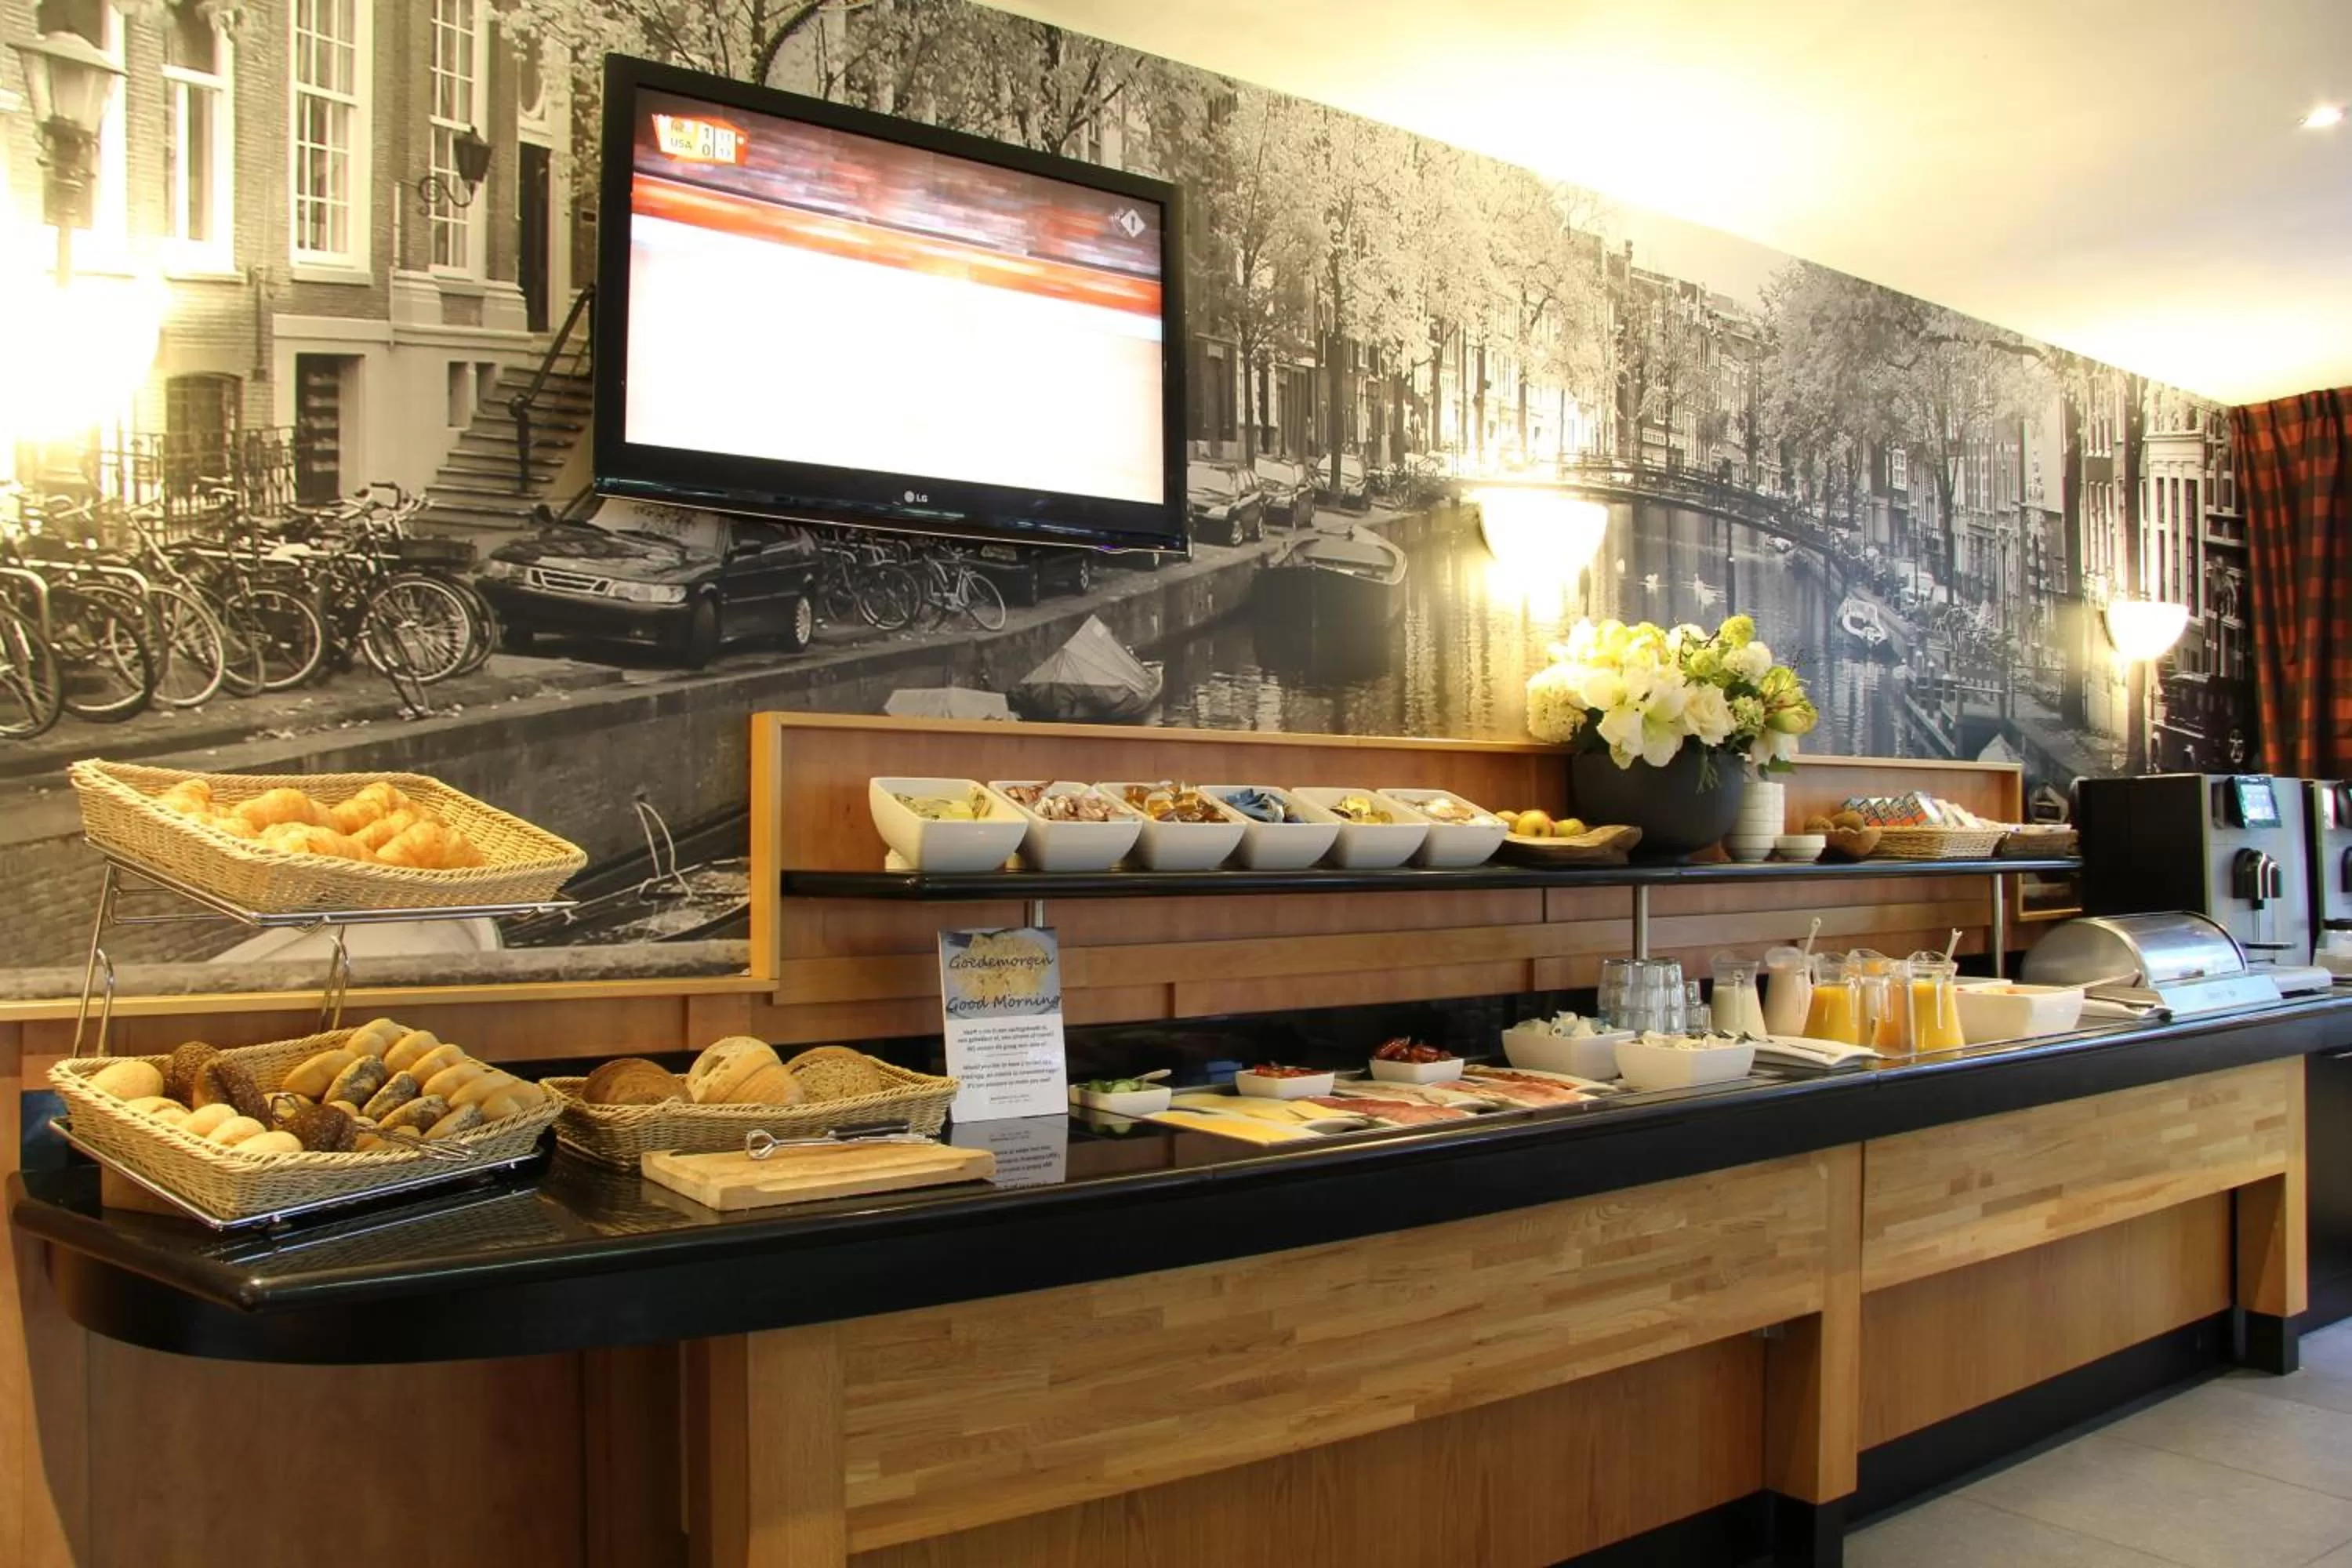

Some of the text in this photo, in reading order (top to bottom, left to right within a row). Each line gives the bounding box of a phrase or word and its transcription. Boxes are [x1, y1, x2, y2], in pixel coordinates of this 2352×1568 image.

[670, 137, 692, 151] USA
[916, 493, 928, 503] LG
[949, 953, 1054, 970] Goedemorgen
[946, 993, 1061, 1012] Good Morning
